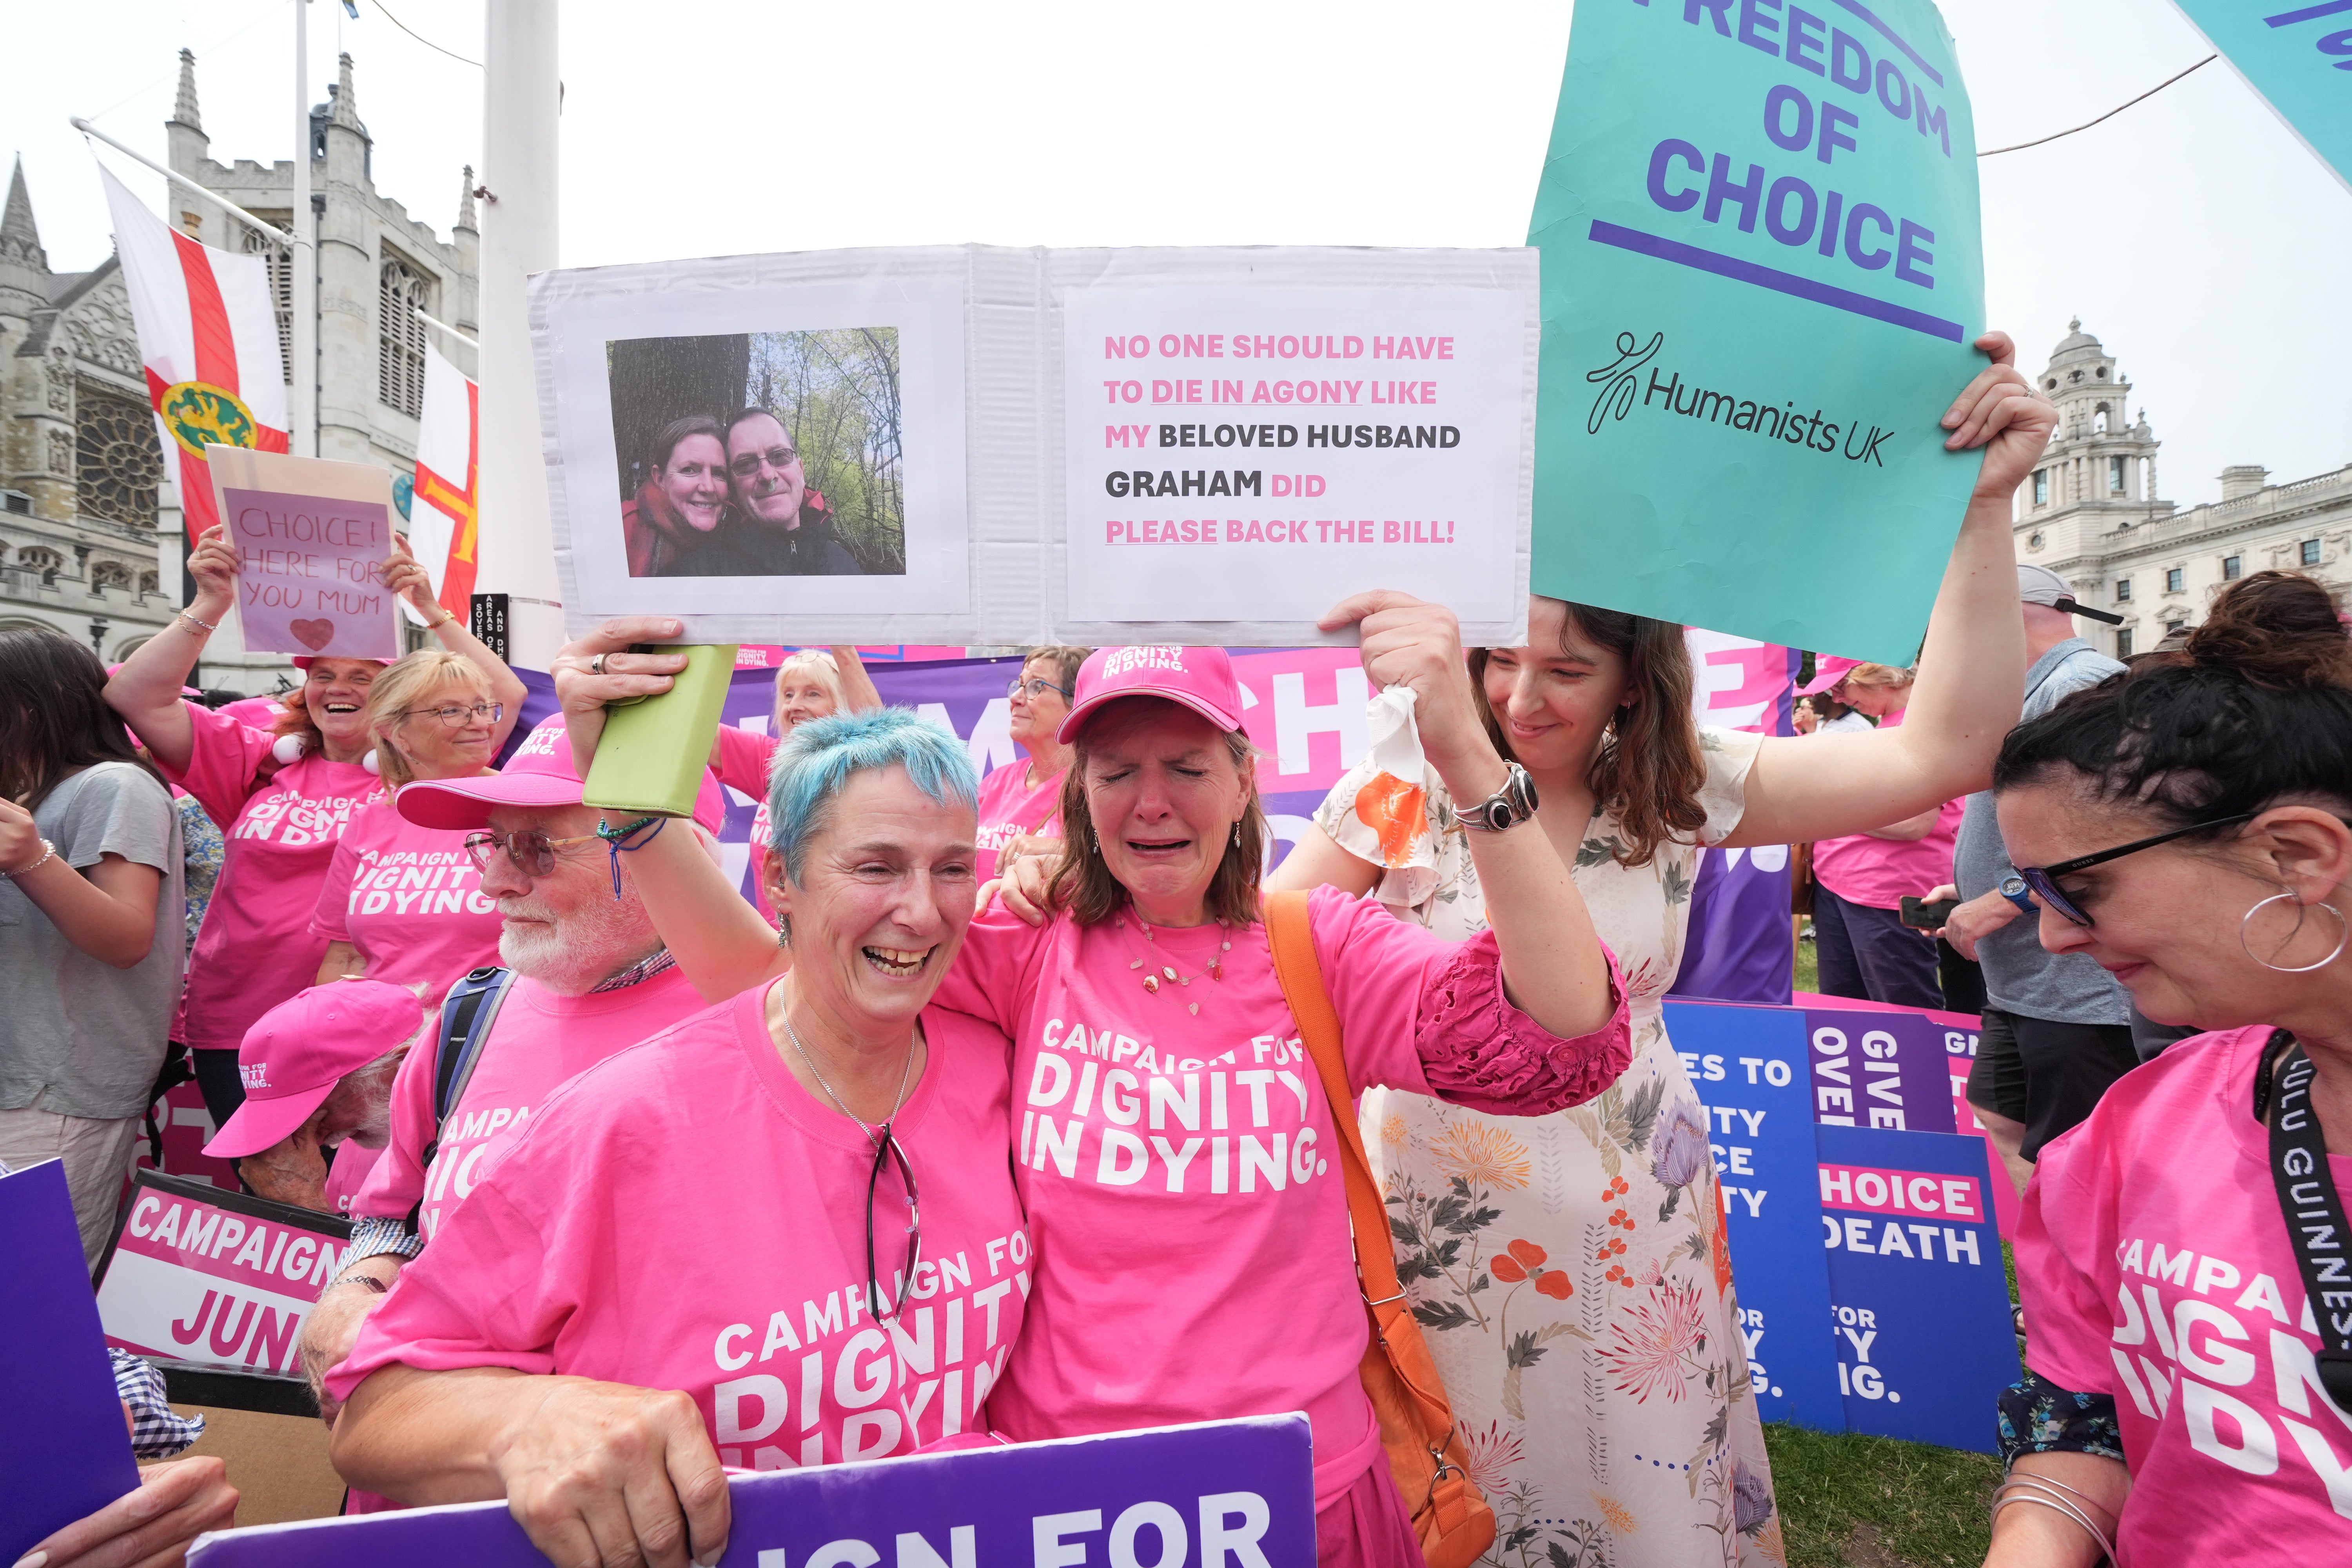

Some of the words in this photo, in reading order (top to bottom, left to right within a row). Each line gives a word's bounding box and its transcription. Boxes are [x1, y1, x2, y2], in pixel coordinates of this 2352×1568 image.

[1764, 84, 1858, 165] OF
[1646, 138, 1935, 289] CHOICE
[1105, 336, 1150, 359] NO
[1159, 334, 1224, 358] ONE
[1232, 335, 1364, 359] SHOULD
[1373, 336, 1454, 359] HAVE
[1104, 380, 1143, 403] TO
[1152, 380, 1202, 403] DIE
[1212, 380, 1243, 403] IN
[1251, 380, 1363, 404] AGONY
[1372, 381, 1436, 404] LIKE
[1105, 425, 1151, 448] MY
[1160, 425, 1298, 447] BELOVED
[1307, 425, 1461, 448] HUSBAND
[1644, 367, 1839, 452] Humanists
[1844, 420, 1894, 467] UK
[1105, 470, 1261, 497] GRAHAM
[1272, 475, 1326, 497] DID
[240, 508, 375, 547] CHOICE!
[1106, 520, 1218, 543] PLEASE
[1227, 520, 1308, 543] BACK
[1316, 521, 1374, 543] THE
[1383, 521, 1455, 543] BILL!
[243, 546, 319, 577] HERE
[338, 558, 383, 584] FOR
[246, 582, 302, 608] YOU
[318, 590, 379, 614] MUM
[1102, 664, 1120, 679] IN
[1123, 658, 1188, 673] DYING.
[1104, 648, 1182, 669] DIGNITY
[235, 818, 278, 840] IN
[358, 849, 459, 867] AMPAIGN
[1043, 1018, 1236, 1075] CAMPAIGN
[1251, 1035, 1303, 1065] FOR
[1027, 1052, 1308, 1131] DIGNITY
[1739, 1057, 1791, 1087] TO
[1862, 1030, 1906, 1131] GIVE
[2281, 1058, 2313, 1131] LULU
[1020, 1110, 1084, 1179] IN
[1096, 1127, 1327, 1194] DYING.
[1819, 1169, 1975, 1216] HOICE
[130, 1196, 345, 1286] CAMPAIGN
[2283, 1147, 2352, 1350] GUINNES
[714, 1251, 972, 1371] CAMPAIGN
[1033, 1491, 1272, 1568] FOR
